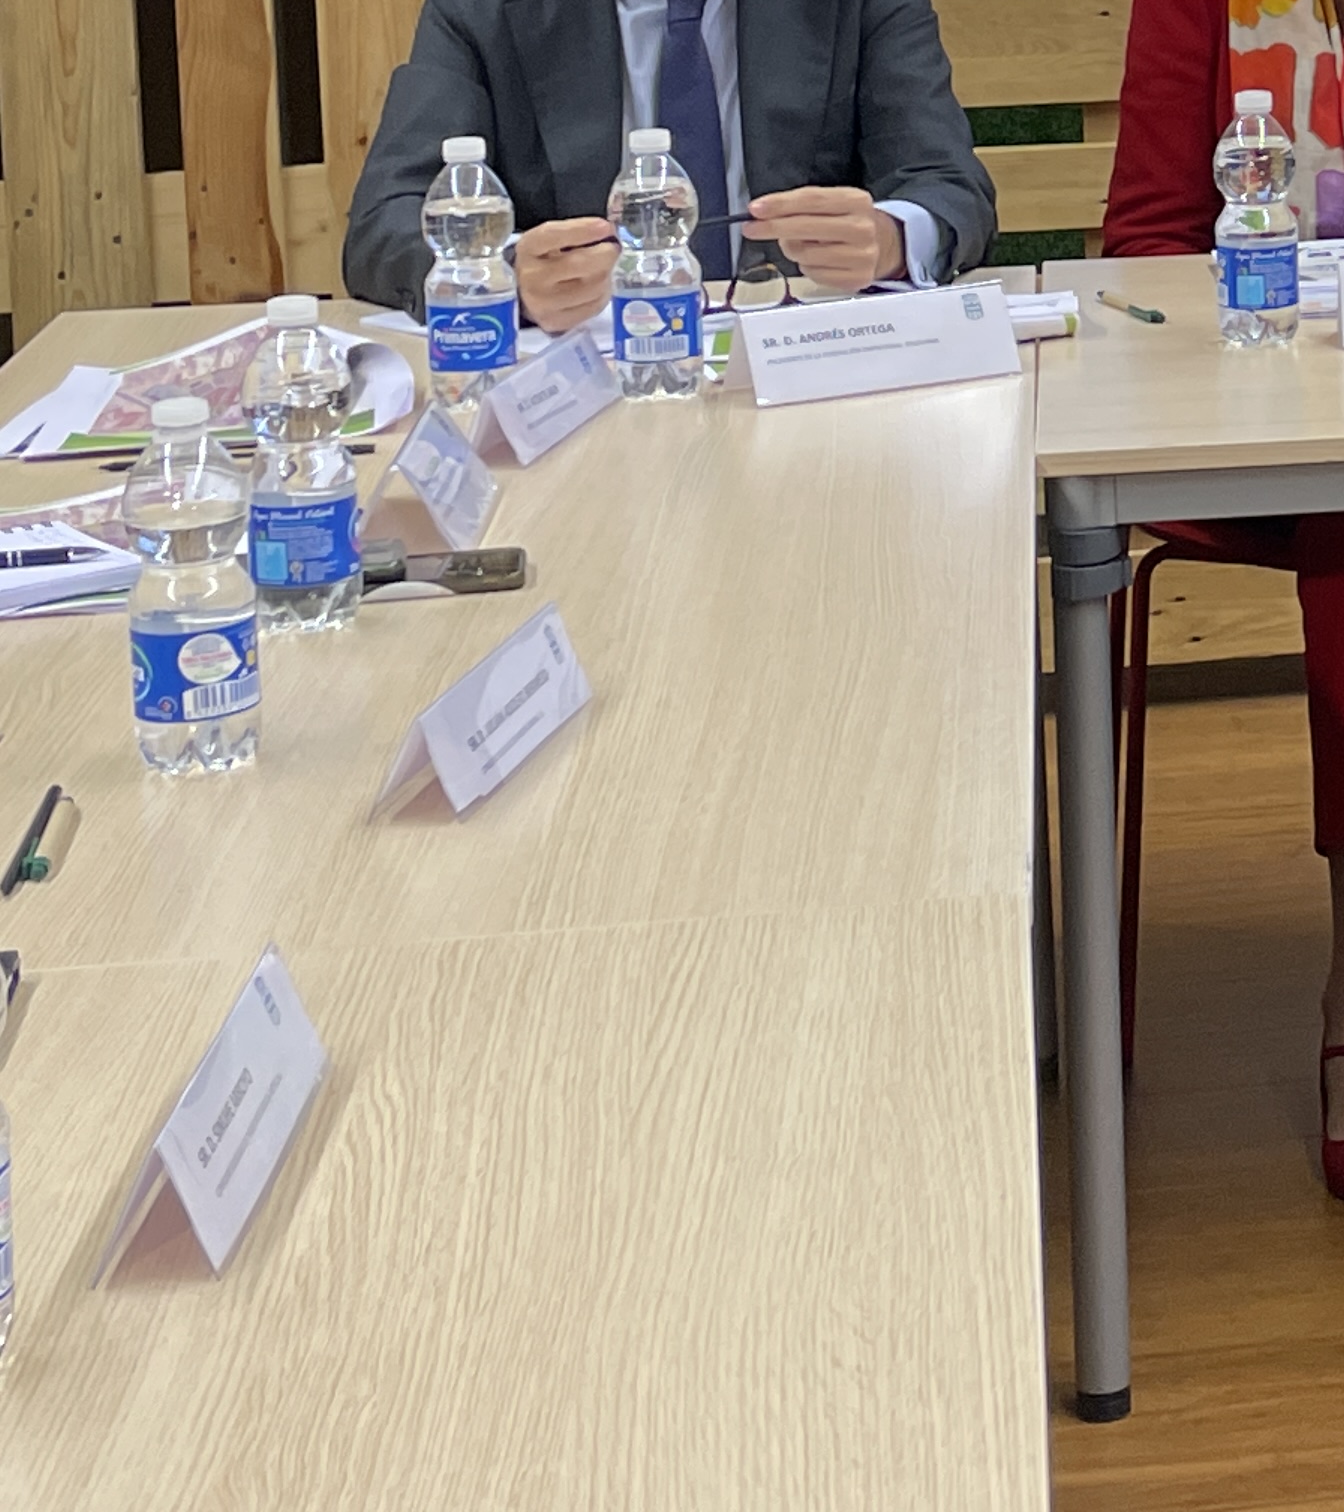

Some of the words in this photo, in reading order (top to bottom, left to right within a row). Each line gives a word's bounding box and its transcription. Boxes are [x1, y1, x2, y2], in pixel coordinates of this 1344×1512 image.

[433, 329, 497, 344] Primavera
[783, 336, 796, 346] D.
[799, 326, 846, 344] ANDRÉS
[847, 323, 896, 338] ORTEGA
